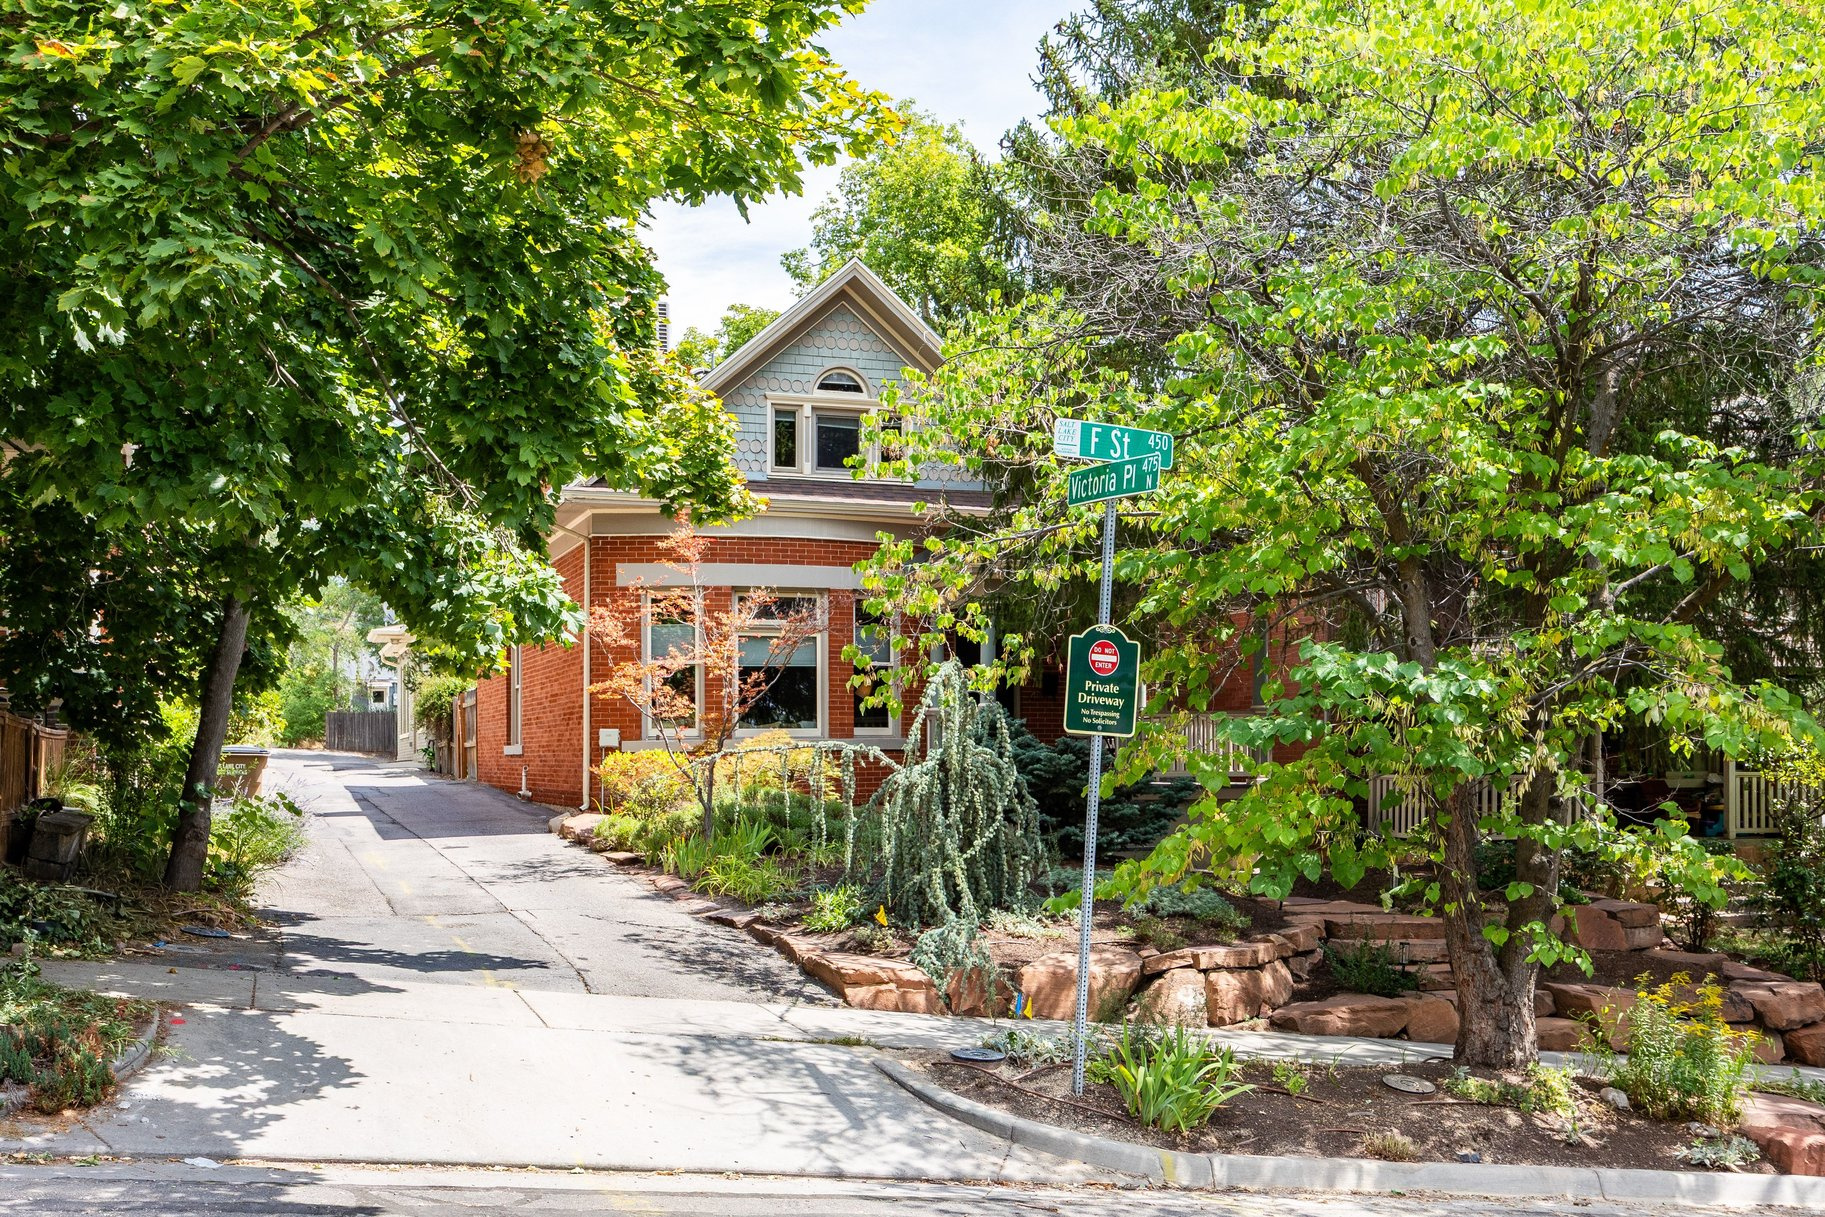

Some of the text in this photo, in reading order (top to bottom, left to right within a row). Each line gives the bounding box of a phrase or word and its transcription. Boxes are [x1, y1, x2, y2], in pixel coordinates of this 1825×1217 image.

[1059, 420, 1075, 428] SALT
[1058, 434, 1075, 442] CITY
[1090, 427, 1169, 459] F St 450
[1142, 455, 1159, 473] 475
[1071, 464, 1137, 500] Victoria Pl
[1145, 474, 1152, 489] N
[1095, 661, 1112, 669] ENTER
[1085, 680, 1120, 694] Private
[1078, 692, 1125, 709] Driveway
[1090, 709, 1120, 719] Trespassing
[1092, 718, 1117, 726] Solicitors
